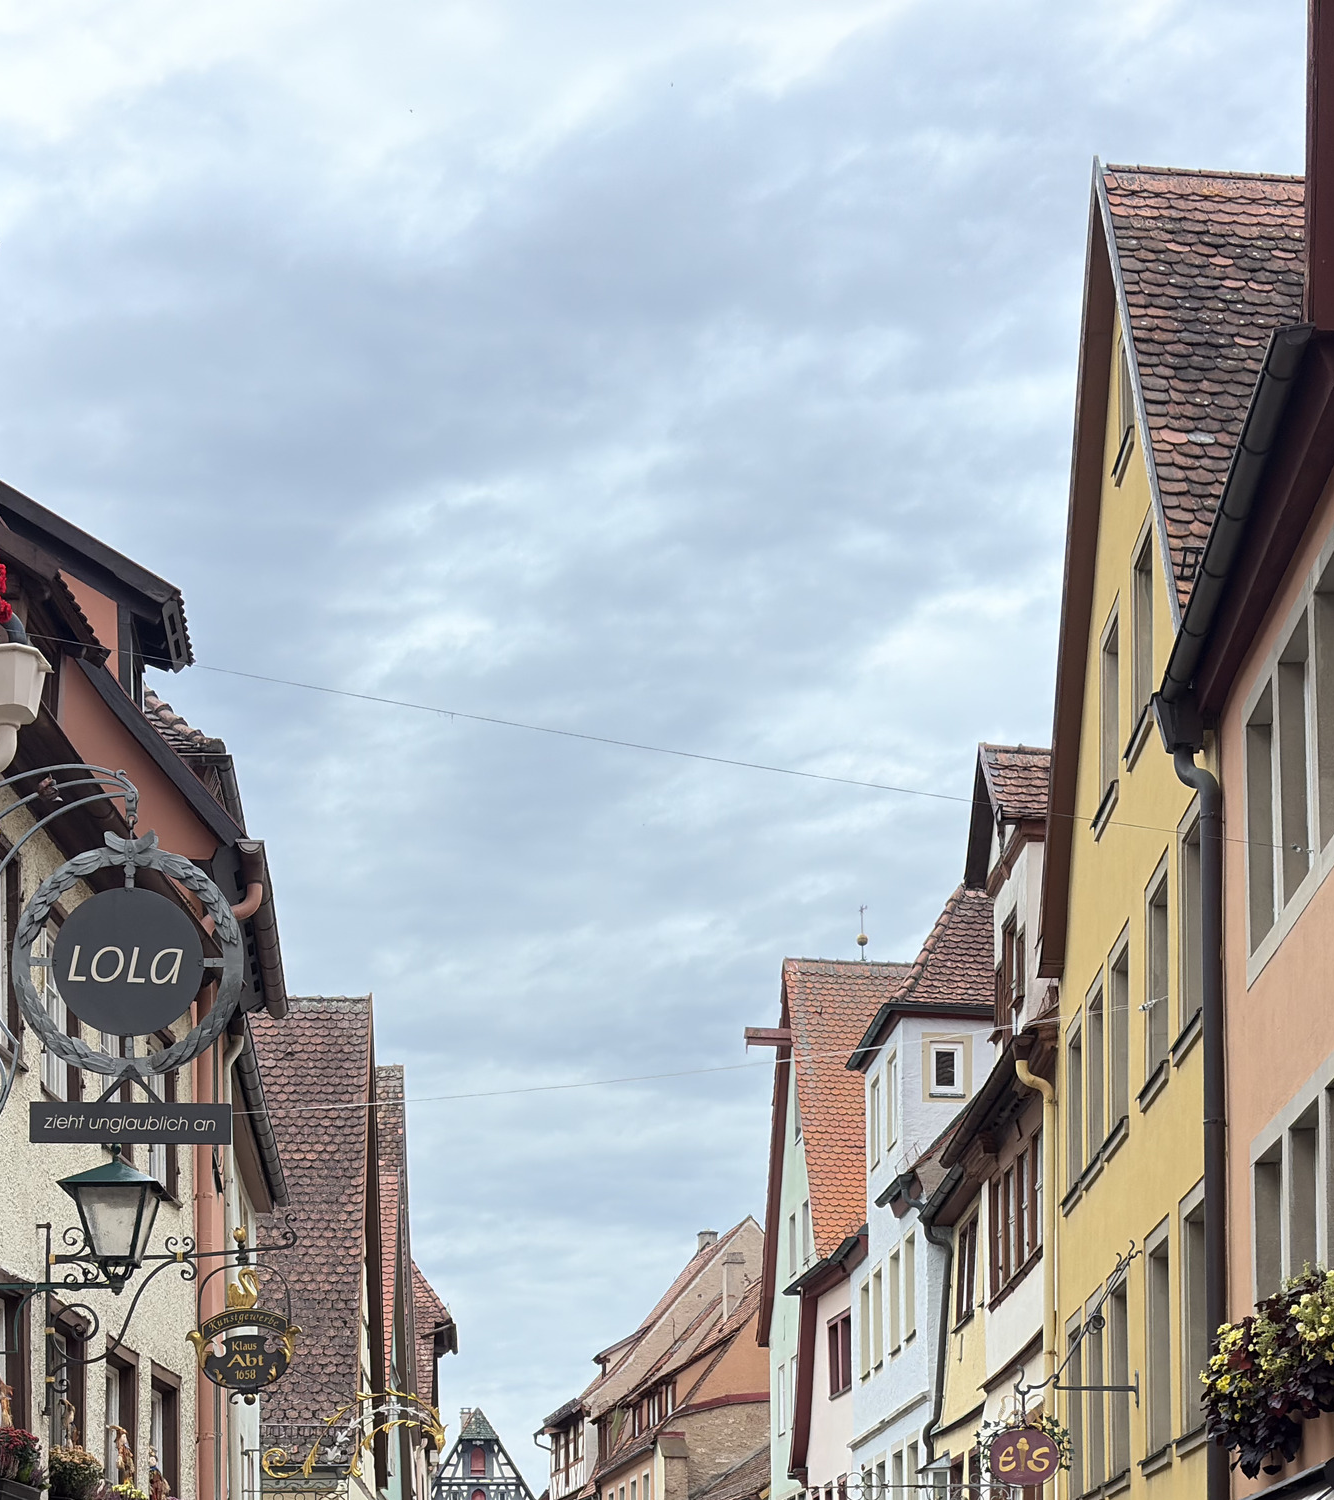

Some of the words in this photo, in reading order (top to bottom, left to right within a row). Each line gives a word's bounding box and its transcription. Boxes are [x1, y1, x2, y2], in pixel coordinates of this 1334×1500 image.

[43, 1113, 85, 1130] zieht
[88, 1115, 189, 1134] unglaublich
[193, 1118, 216, 1132] an
[208, 1312, 280, 1332] Kunstgewerbe
[231, 1341, 258, 1351] Klaus
[226, 1354, 265, 1368] Abt
[234, 1369, 257, 1380] 1658
